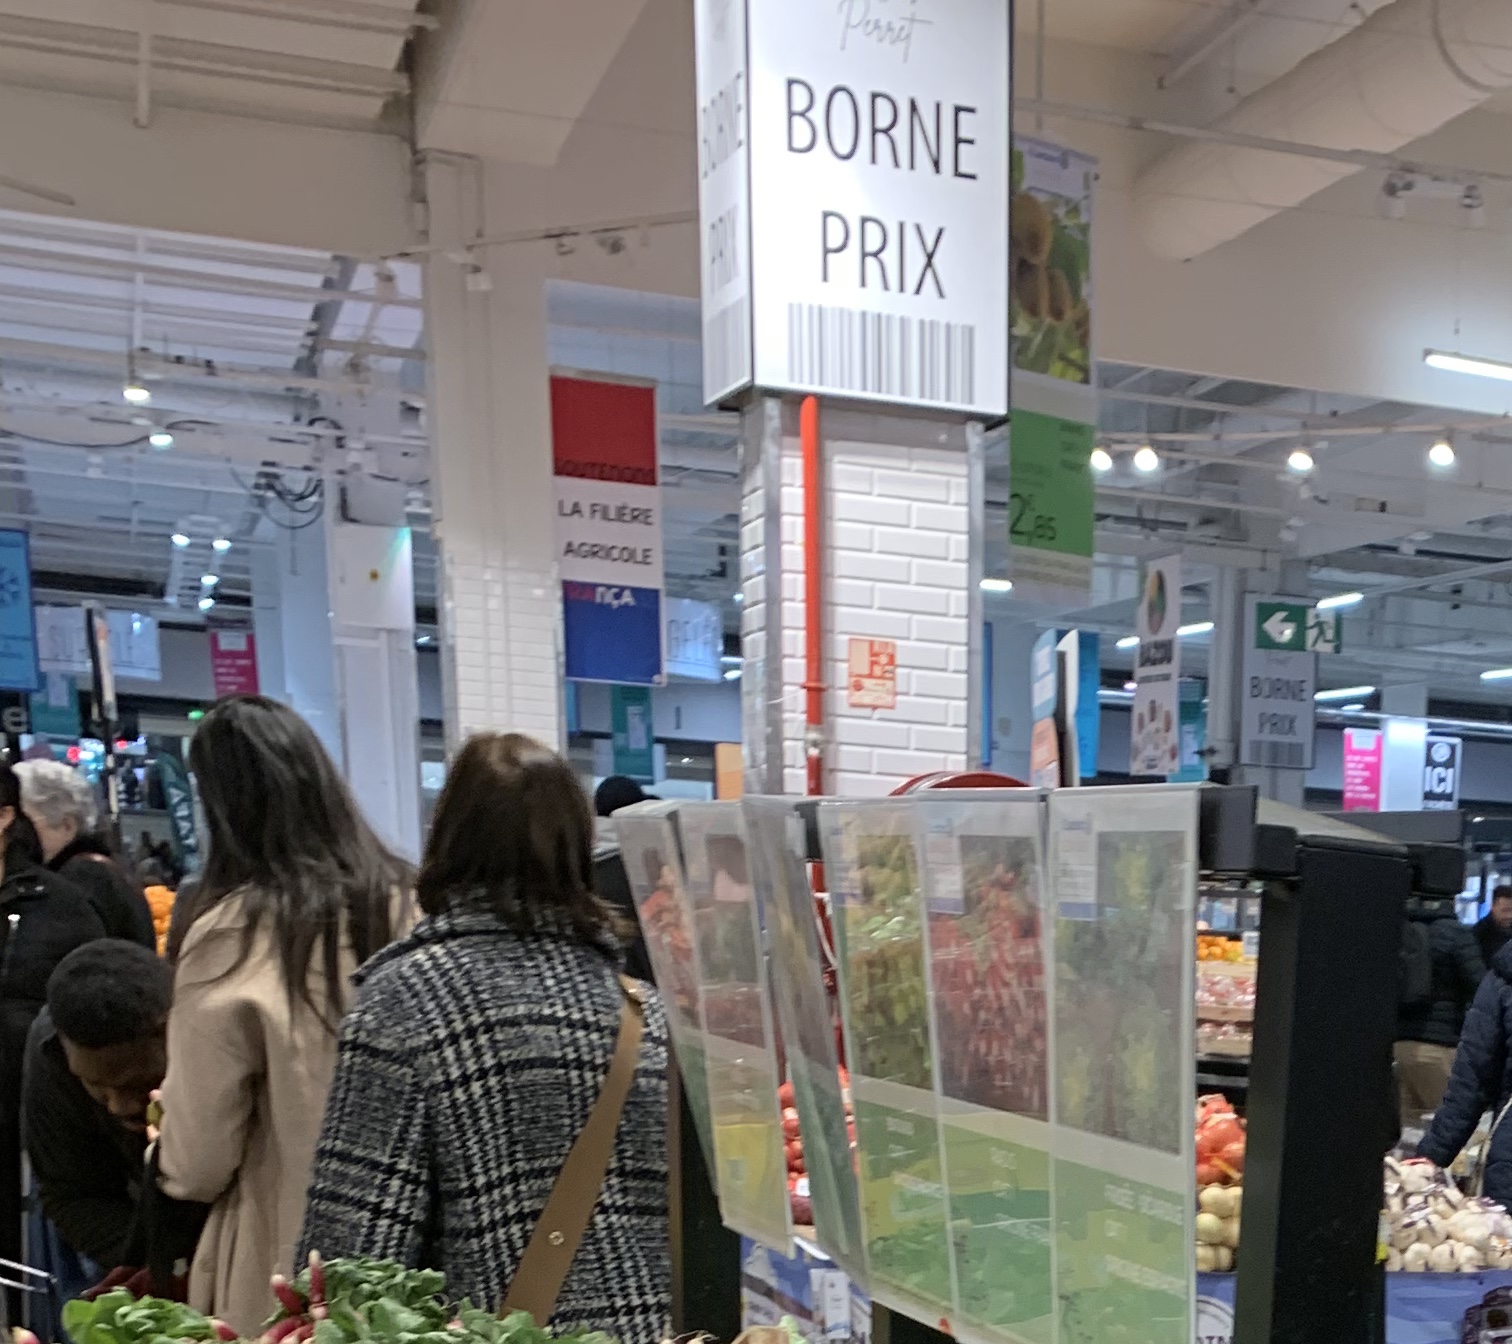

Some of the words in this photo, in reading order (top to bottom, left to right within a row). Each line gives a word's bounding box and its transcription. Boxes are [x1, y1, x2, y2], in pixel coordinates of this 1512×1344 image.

[786, 77, 978, 181] BORNE
[821, 210, 946, 300] PRIX
[558, 499, 583, 518] LA
[589, 502, 654, 526] FILIÈRE
[563, 540, 653, 566] AGRICOLE
[1424, 766, 1454, 794] ICI
